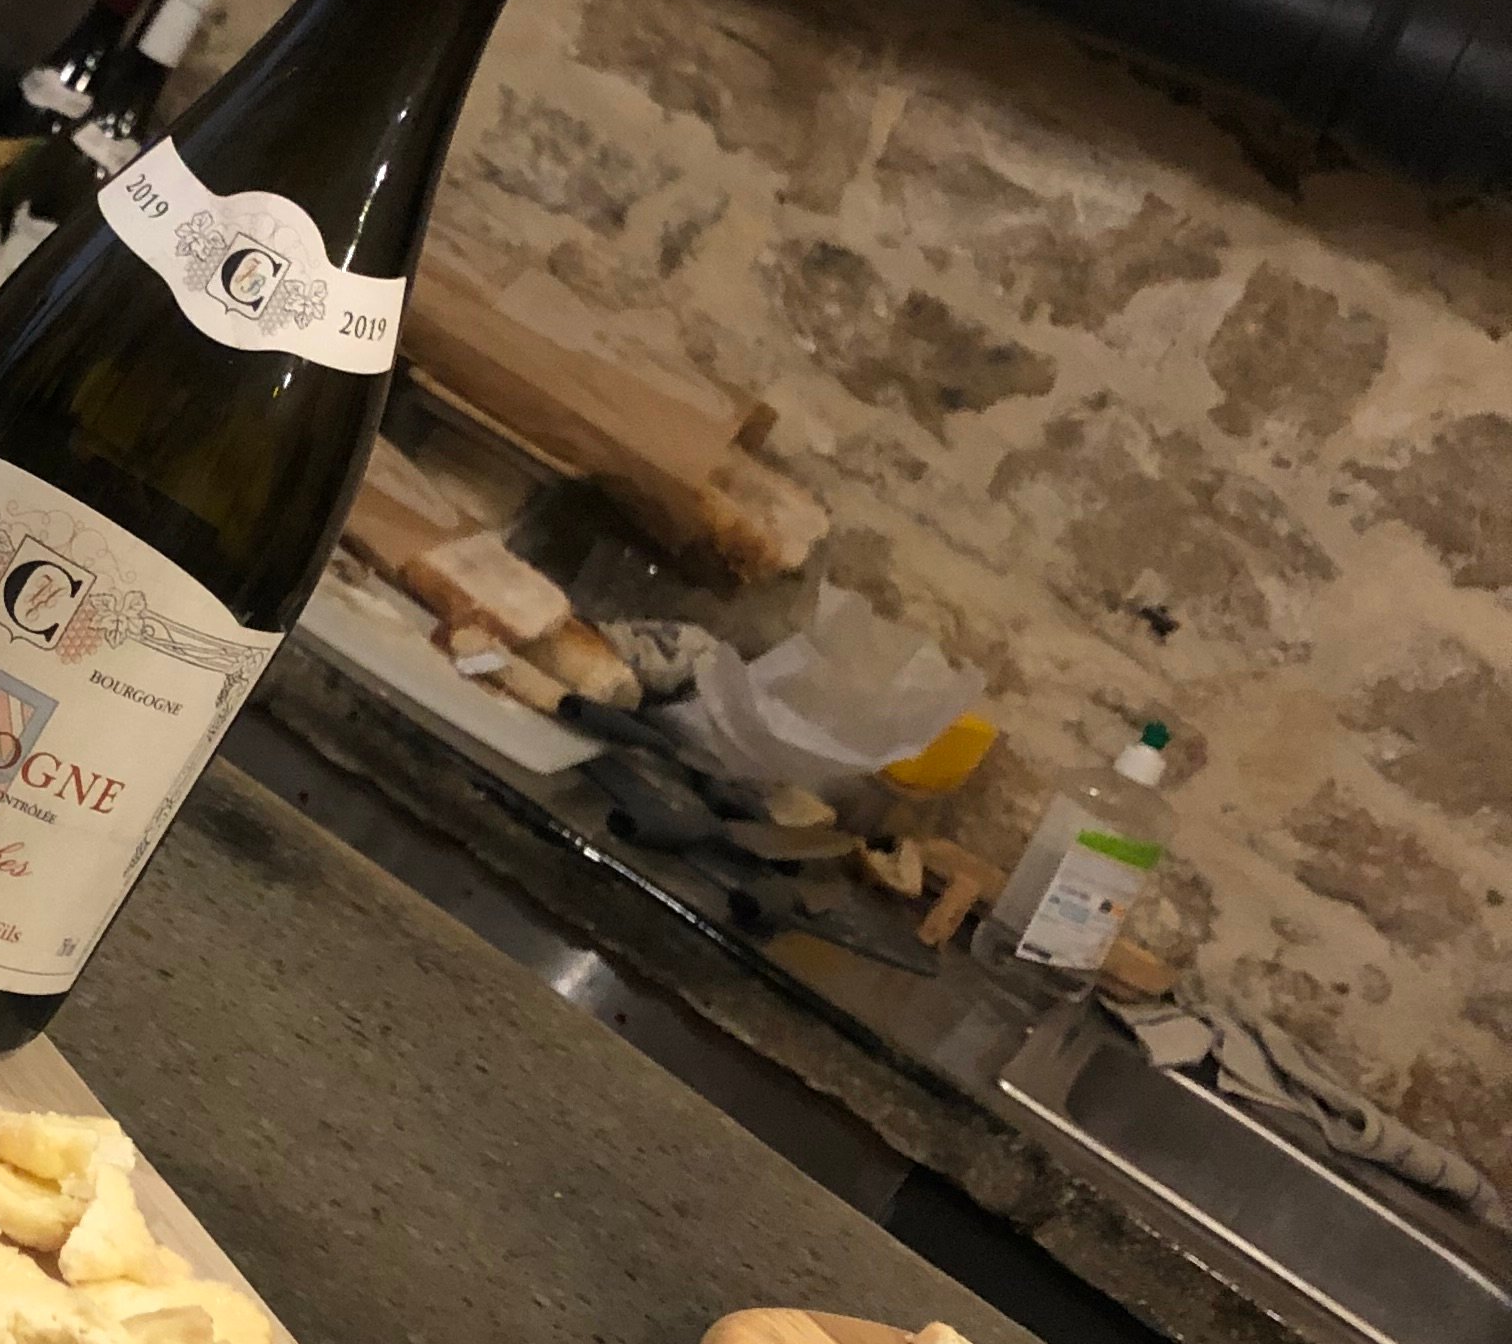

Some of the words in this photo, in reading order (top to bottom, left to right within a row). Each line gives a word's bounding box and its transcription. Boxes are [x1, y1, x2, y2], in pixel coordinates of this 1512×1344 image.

[126, 174, 169, 219] 2019
[221, 248, 282, 312] C
[339, 311, 387, 342] 2019
[3, 560, 83, 642] C
[89, 669, 184, 717] BOURGOGNE
